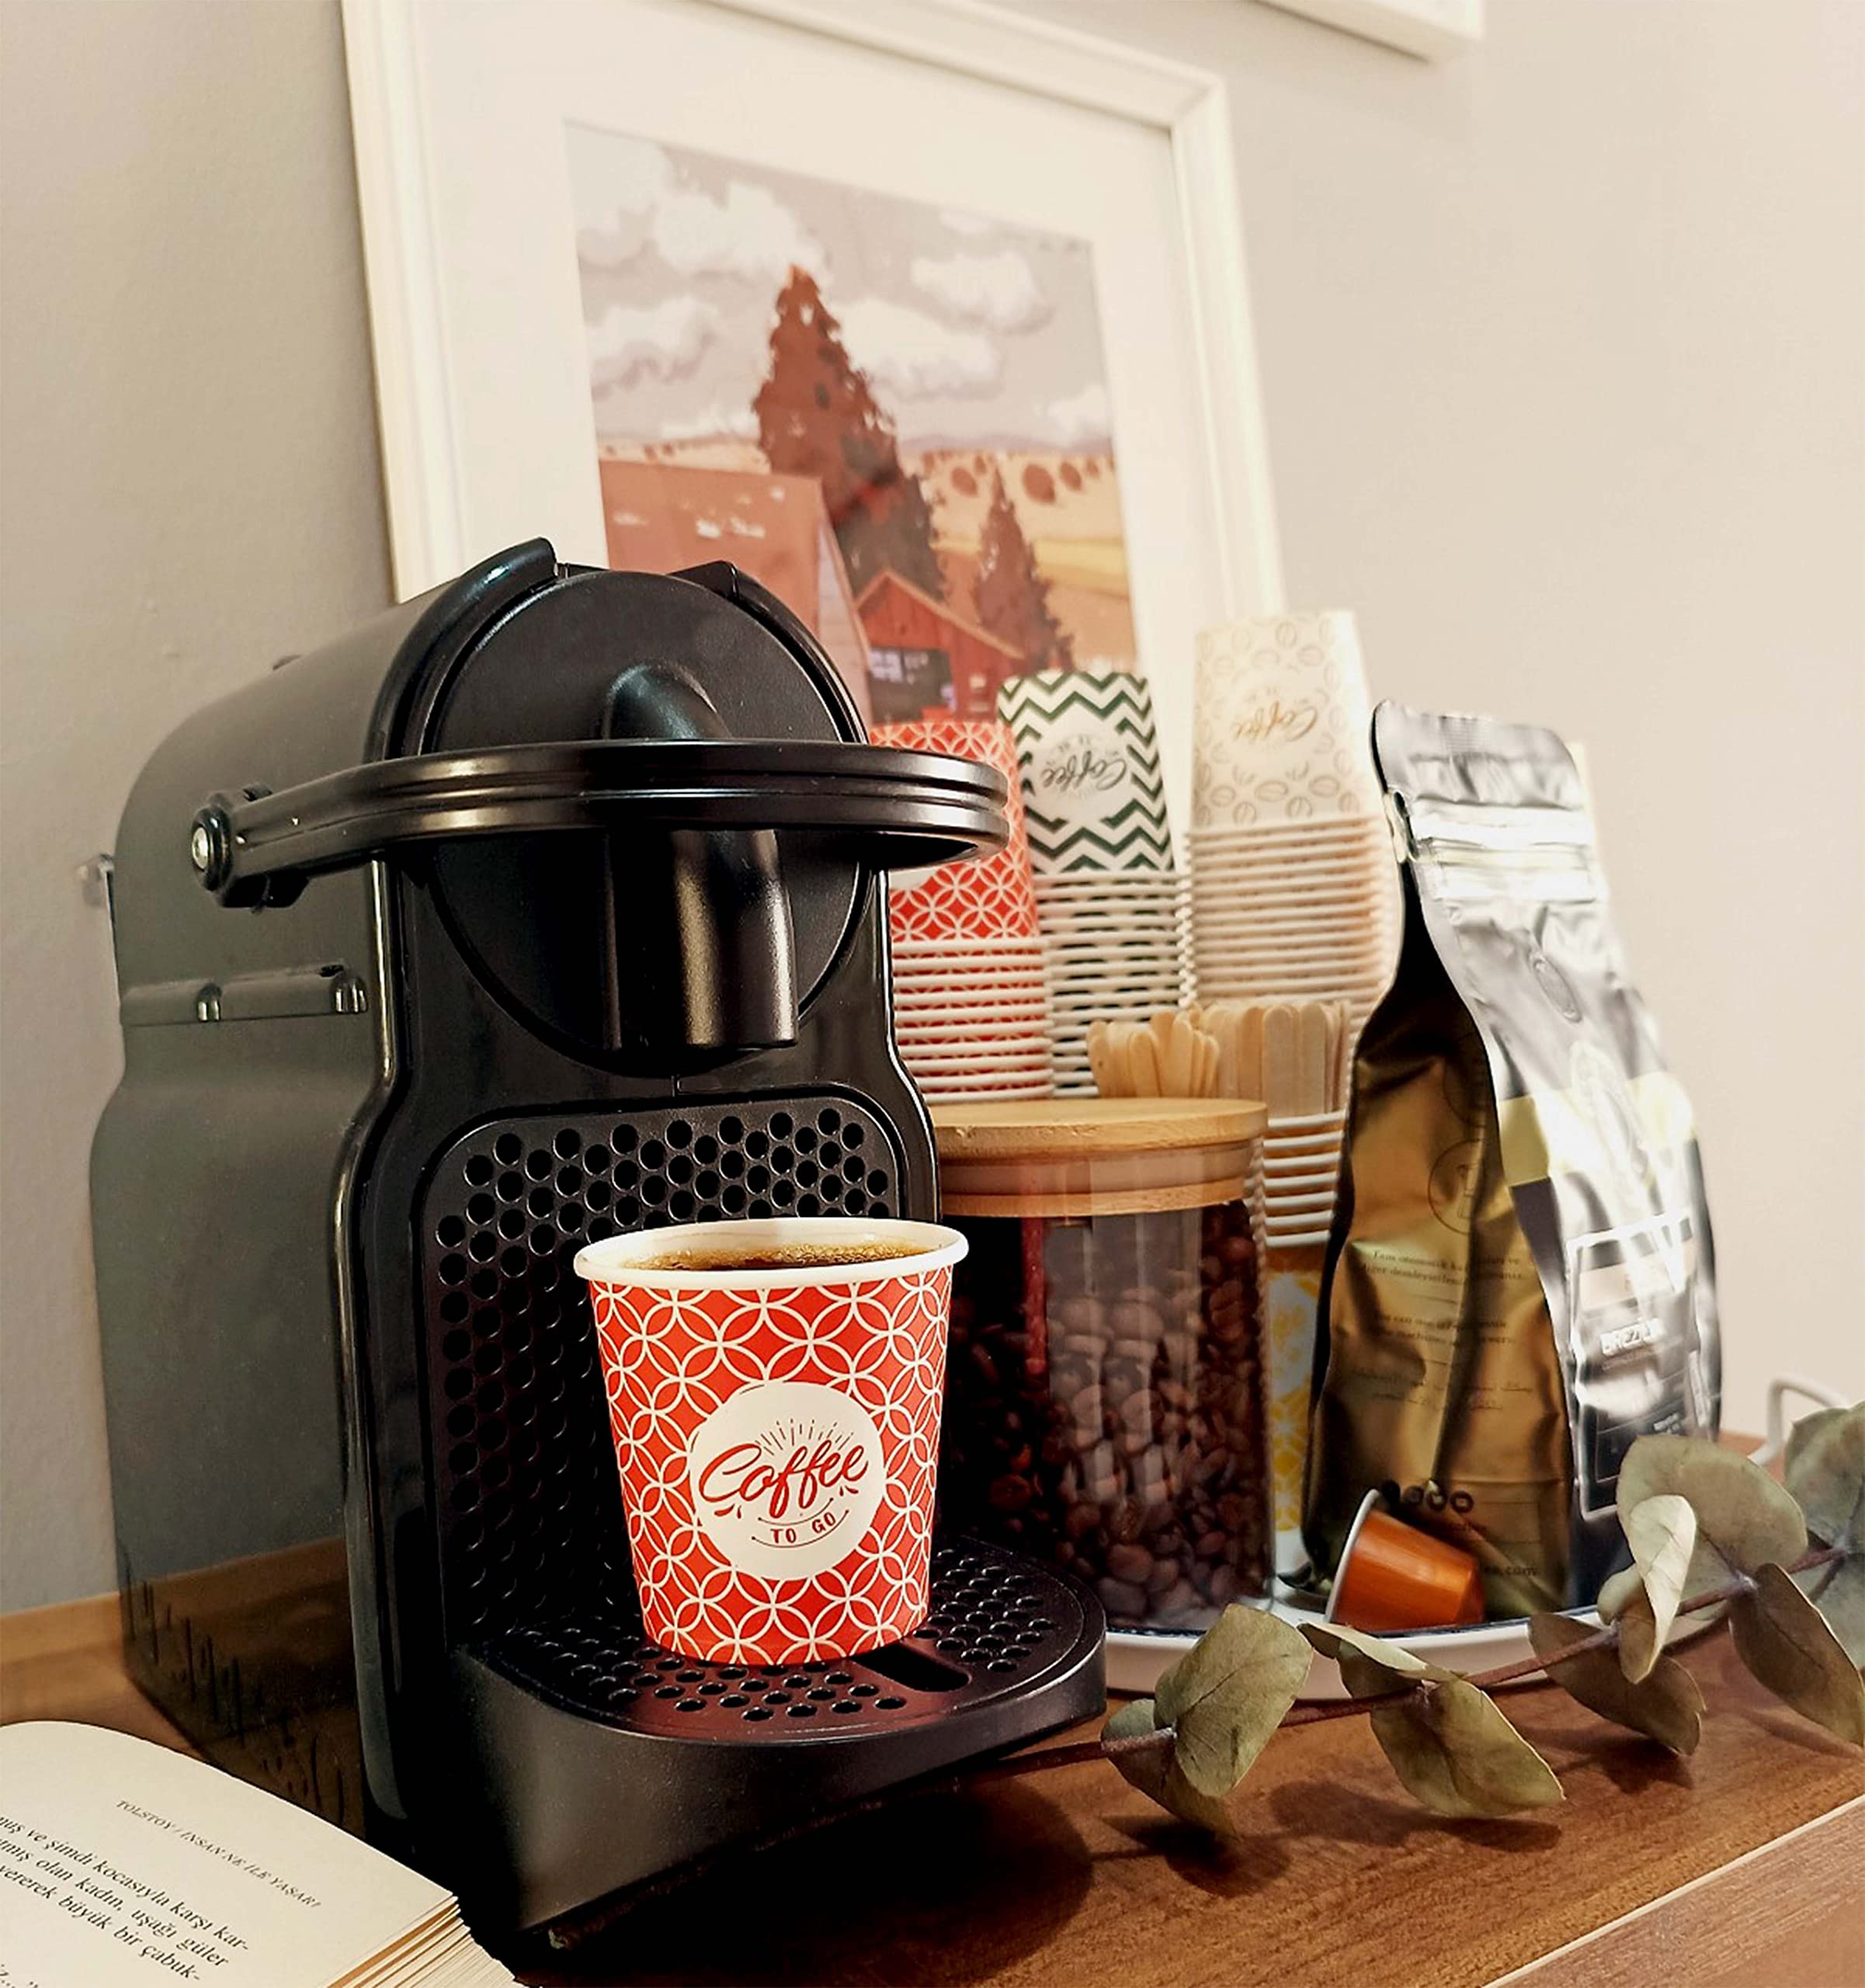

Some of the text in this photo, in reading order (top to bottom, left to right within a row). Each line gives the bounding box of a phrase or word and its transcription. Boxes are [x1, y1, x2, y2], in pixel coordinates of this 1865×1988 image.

[1040, 749, 1127, 793] Coffee
[699, 1440, 869, 1519] Coffee
[770, 1511, 836, 1544] TO GO
[116, 1800, 176, 1830] TOLSTOY
[27, 1828, 47, 1842] ve
[43, 1840, 98, 1865] şimdi
[93, 1860, 170, 1906] kocasıyla
[169, 1901, 214, 1931] karşı
[213, 1926, 248, 1950] kar-
[36, 1859, 73, 1882] olan
[130, 1909, 178, 1938] uşağı
[175, 1938, 229, 1966] güler
[57, 1895, 113, 1930] büyük
[113, 1925, 144, 1947] bir
[138, 1945, 200, 1981] çabuk-
